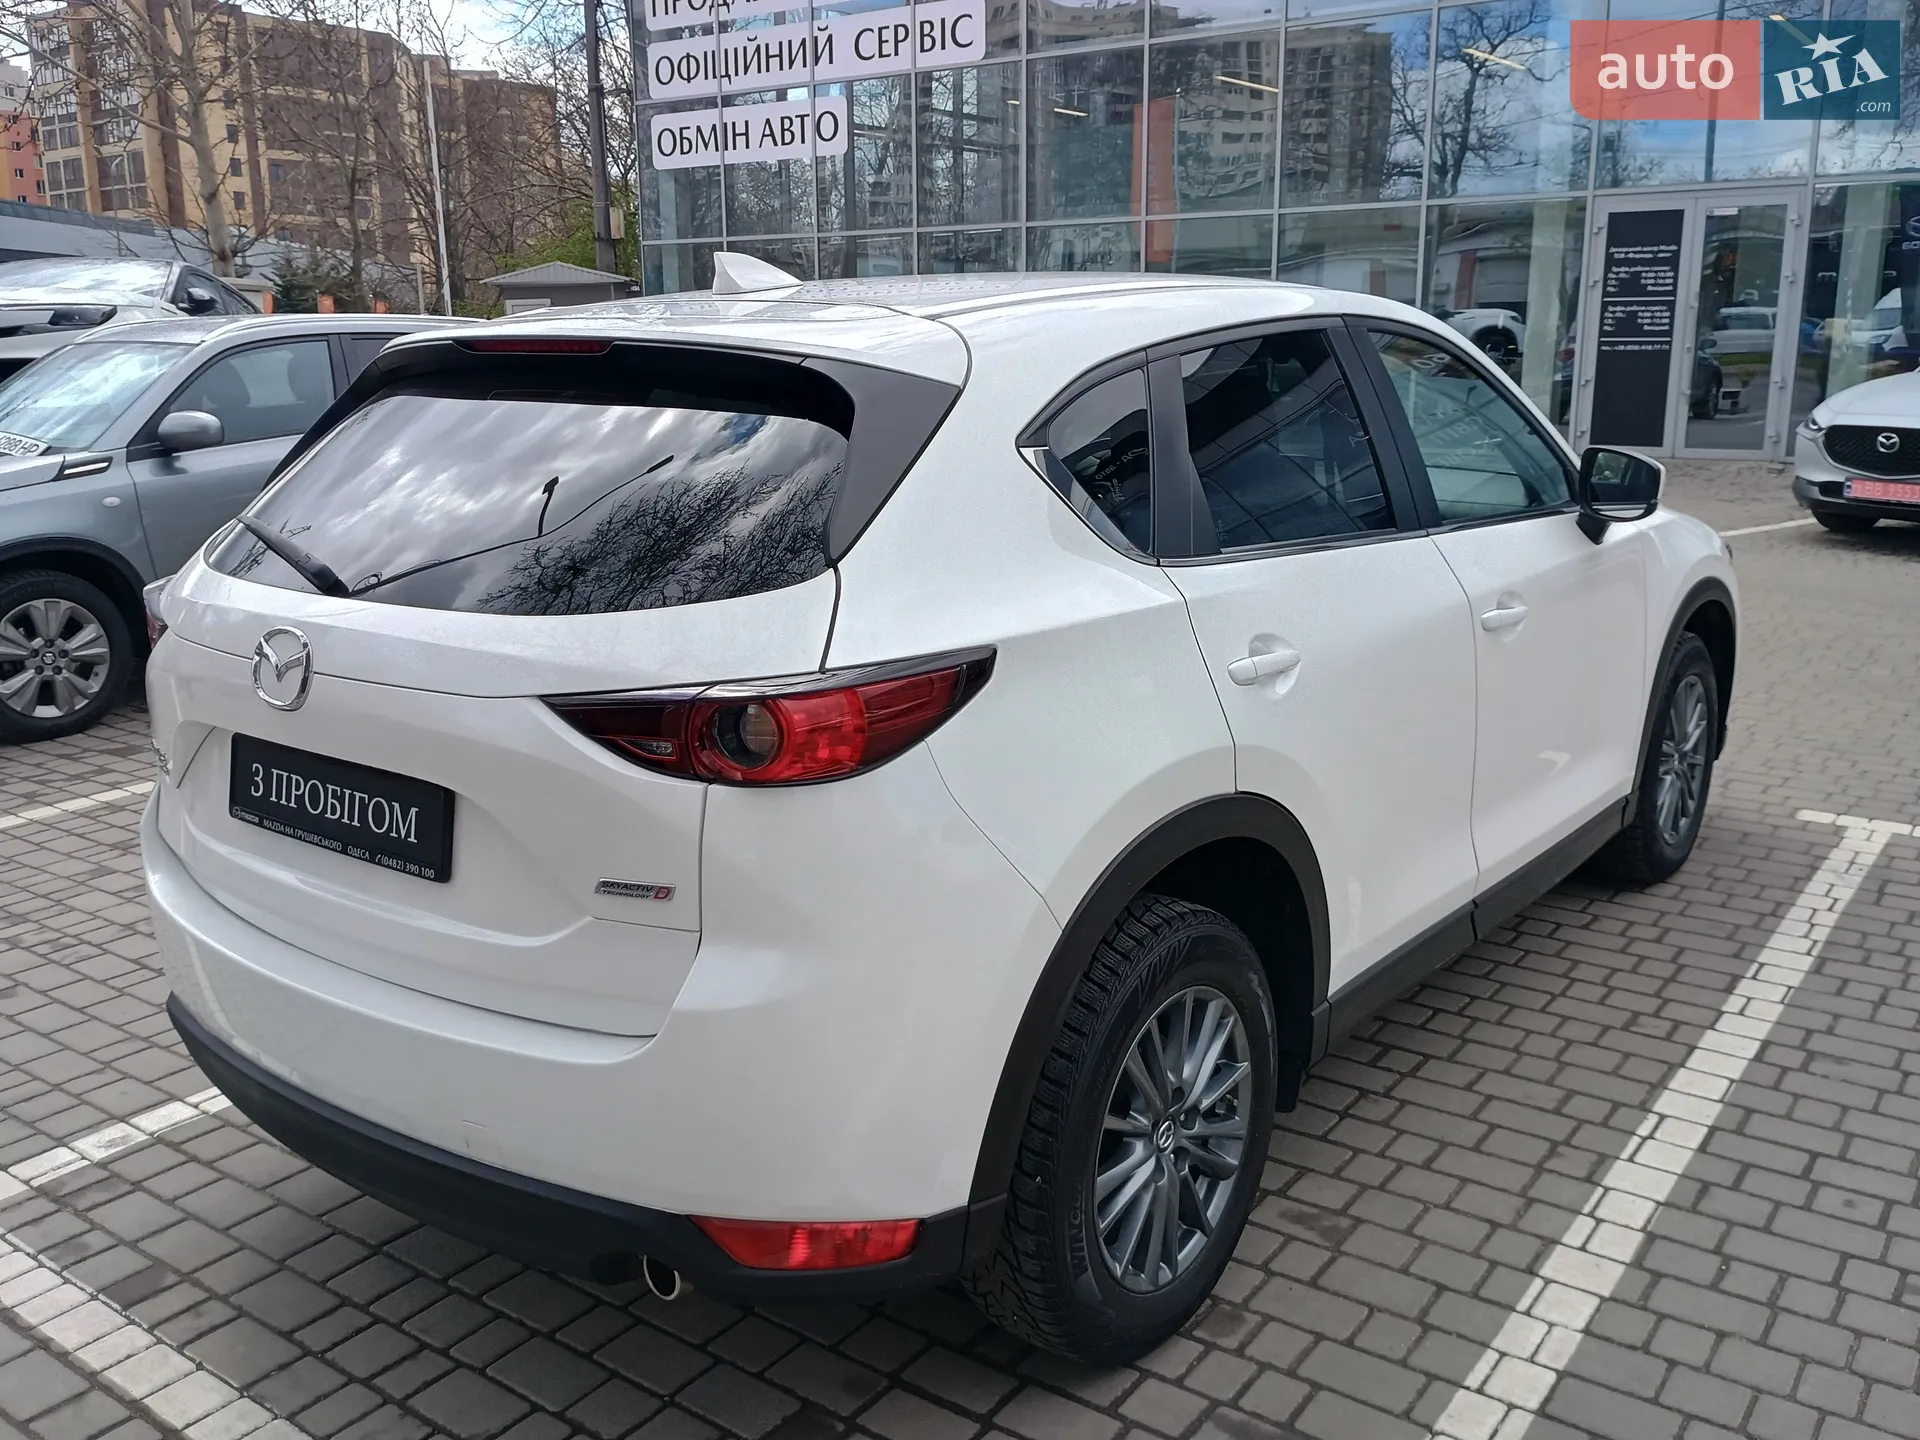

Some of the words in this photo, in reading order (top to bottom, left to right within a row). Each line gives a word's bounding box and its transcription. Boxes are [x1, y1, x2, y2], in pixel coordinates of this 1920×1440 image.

[654, 24, 835, 85] ОФІЦІЙНИЙ
[853, 14, 974, 61] СЕРВІС
[656, 119, 751, 157] ОБМІН
[758, 110, 840, 149] АВТО
[269, 768, 419, 843] ПРОБІГОМ
[263, 819, 285, 832] MAZDA
[285, 825, 294, 836] НА
[347, 845, 370, 860] ОДЕСА
[405, 862, 419, 874] 390
[421, 867, 435, 879] 100
[601, 881, 654, 893] SKYACTIV
